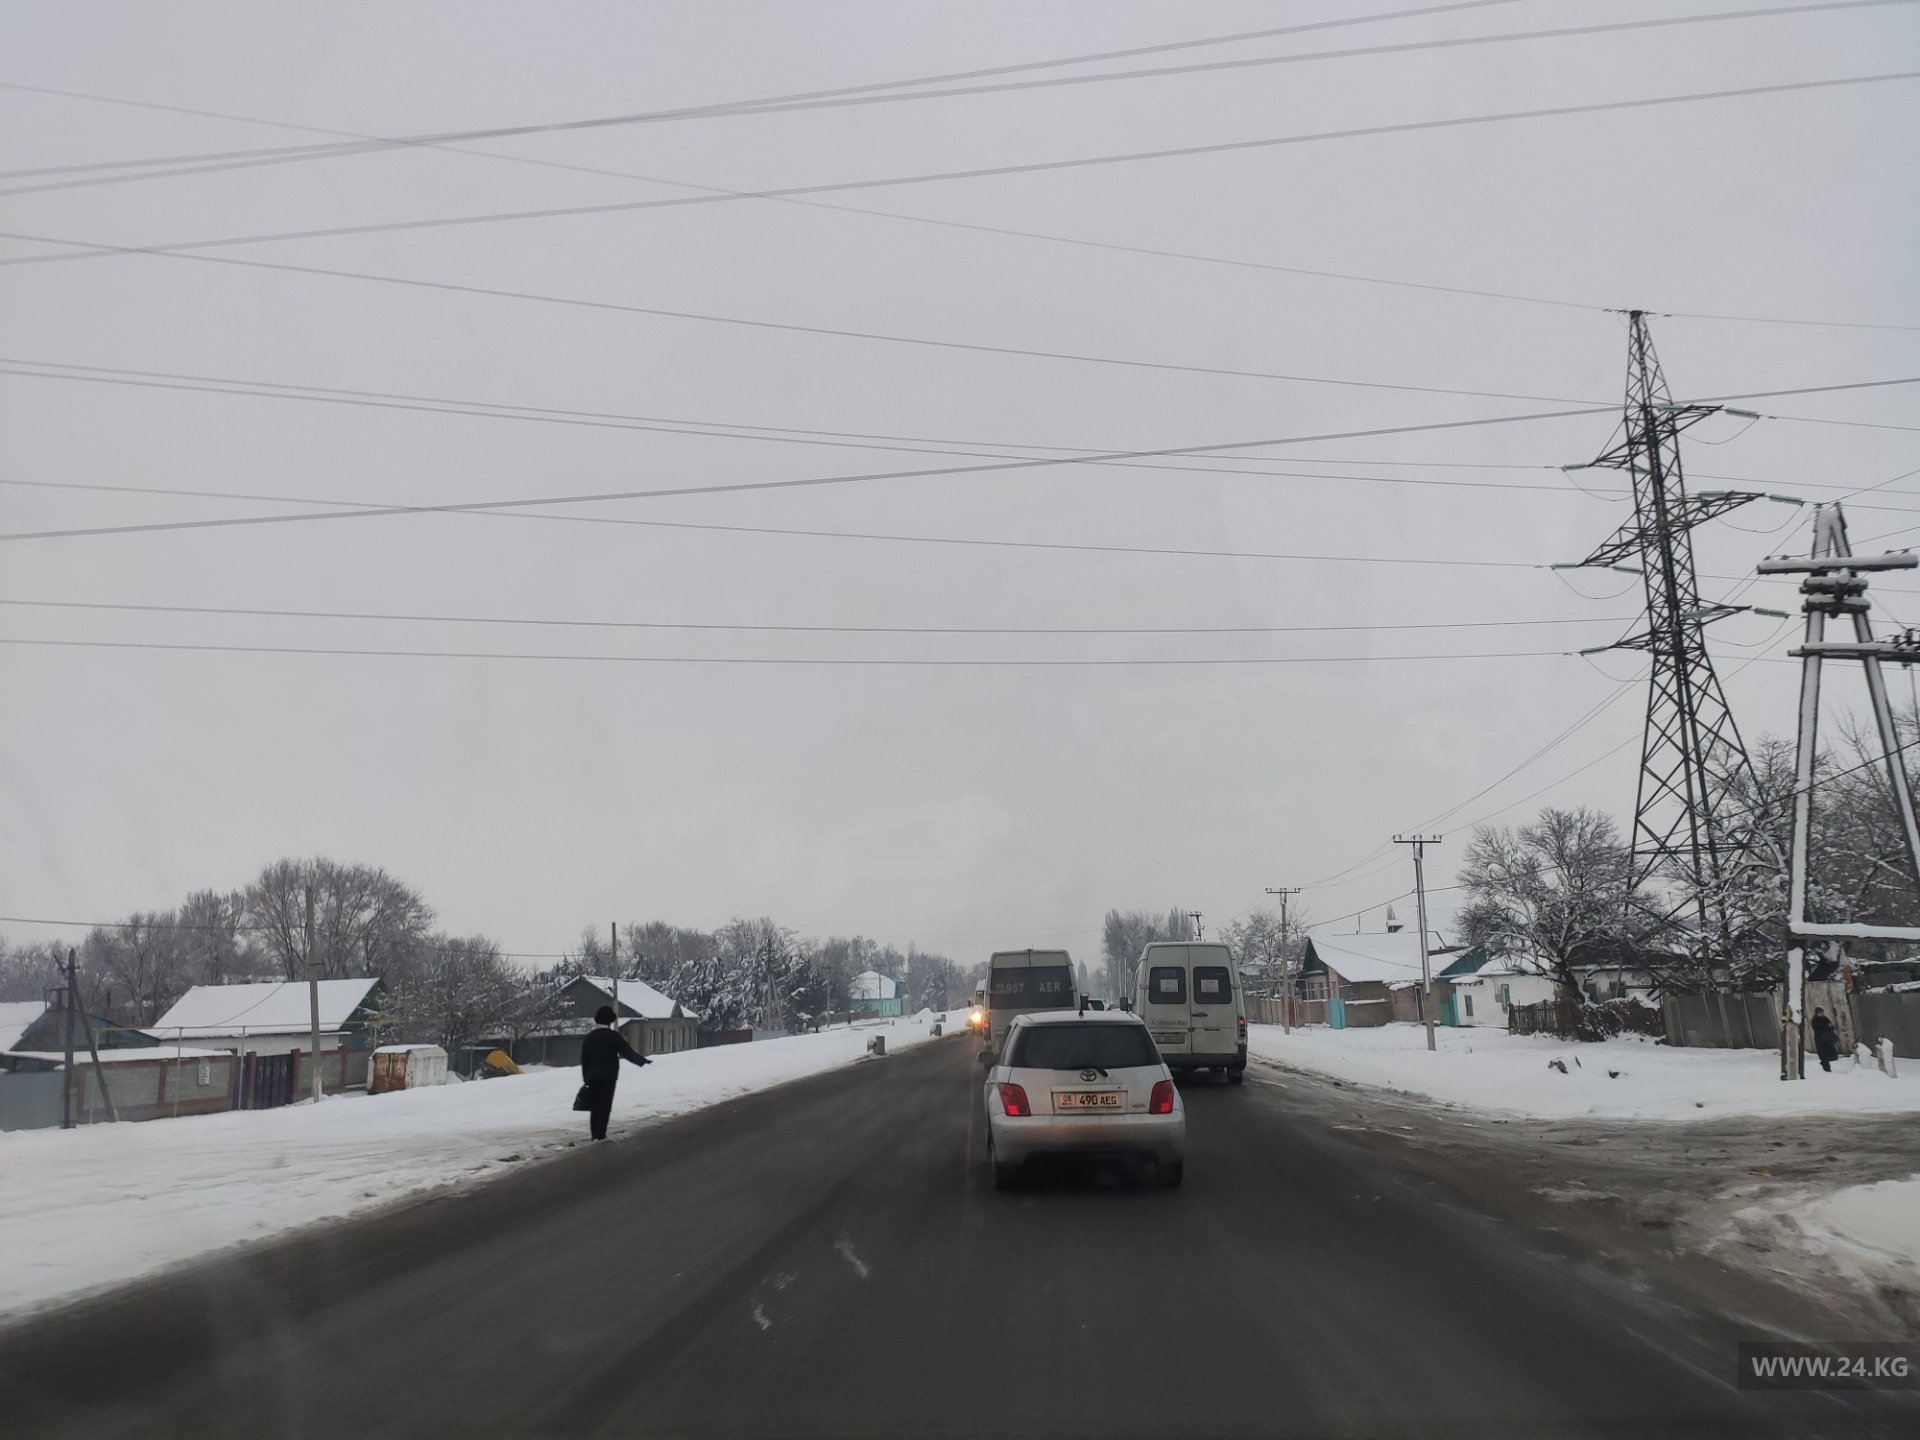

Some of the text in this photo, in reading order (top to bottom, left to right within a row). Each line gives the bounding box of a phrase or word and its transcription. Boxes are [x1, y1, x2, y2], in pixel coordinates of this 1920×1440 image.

[1039, 981, 1061, 993] AER
[1079, 1094, 1098, 1105] 490
[1100, 1095, 1117, 1105] AEG
